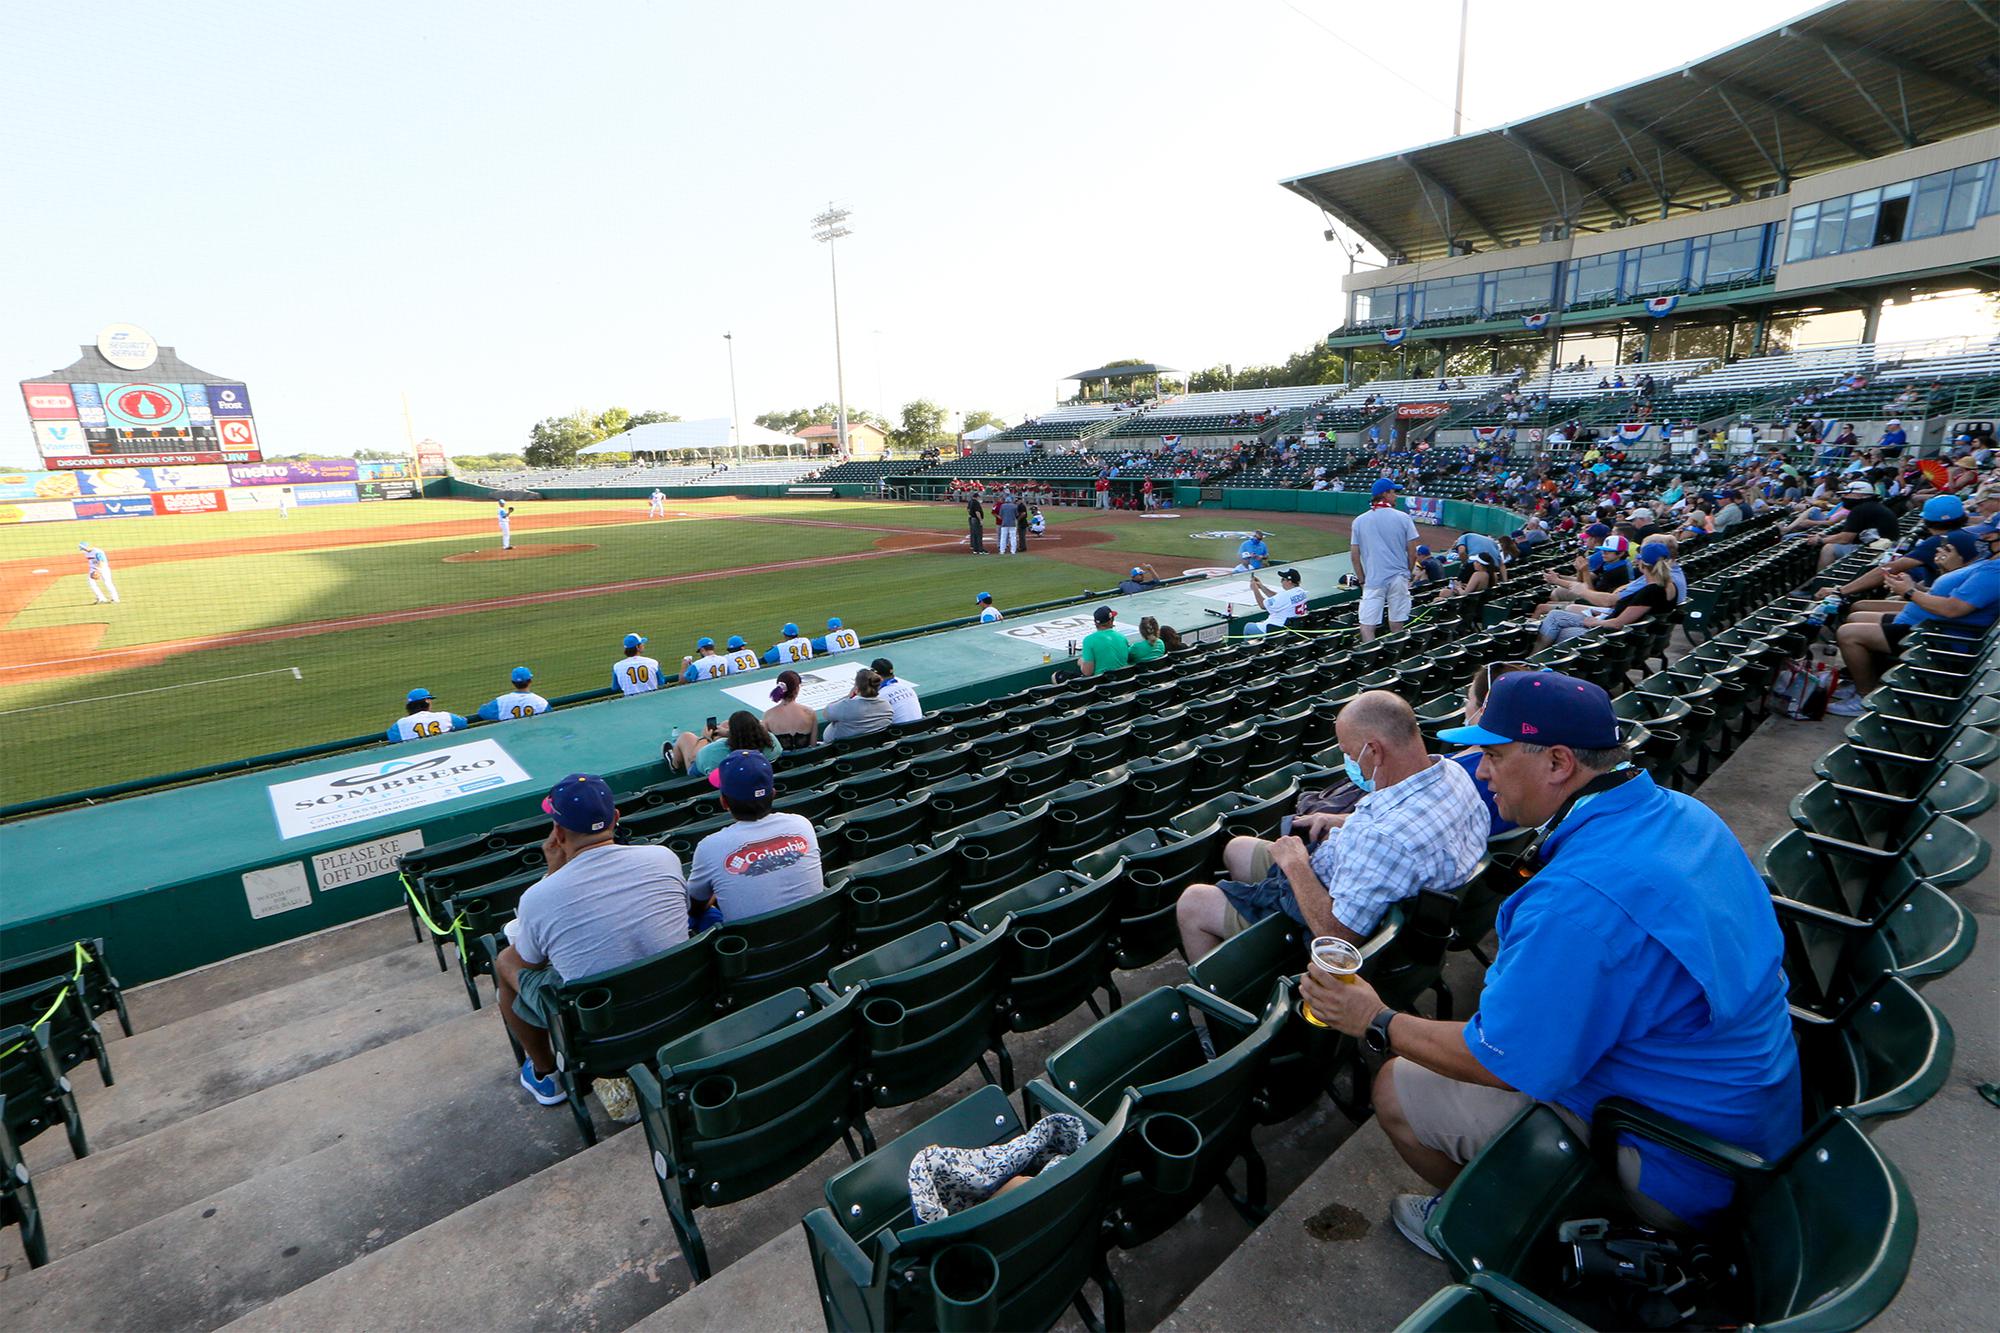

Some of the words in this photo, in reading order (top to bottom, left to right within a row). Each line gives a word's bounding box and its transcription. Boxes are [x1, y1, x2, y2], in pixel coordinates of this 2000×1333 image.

[1398, 406, 1425, 415] Great
[57, 459, 105, 467] DISCOVER
[231, 465, 288, 478] metro
[836, 633, 855, 649] 19
[789, 642, 809, 662] 24
[709, 663, 726, 679] 11
[734, 654, 757, 670] 32
[626, 665, 649, 685] 10
[413, 720, 442, 738] 16
[295, 759, 496, 811] SOMBRERO
[337, 776, 461, 809] CAPITAL
[320, 845, 377, 871] PLEASE
[744, 839, 806, 865] Columbia
[323, 869, 351, 886] OFF
[356, 853, 402, 877] DUGO
